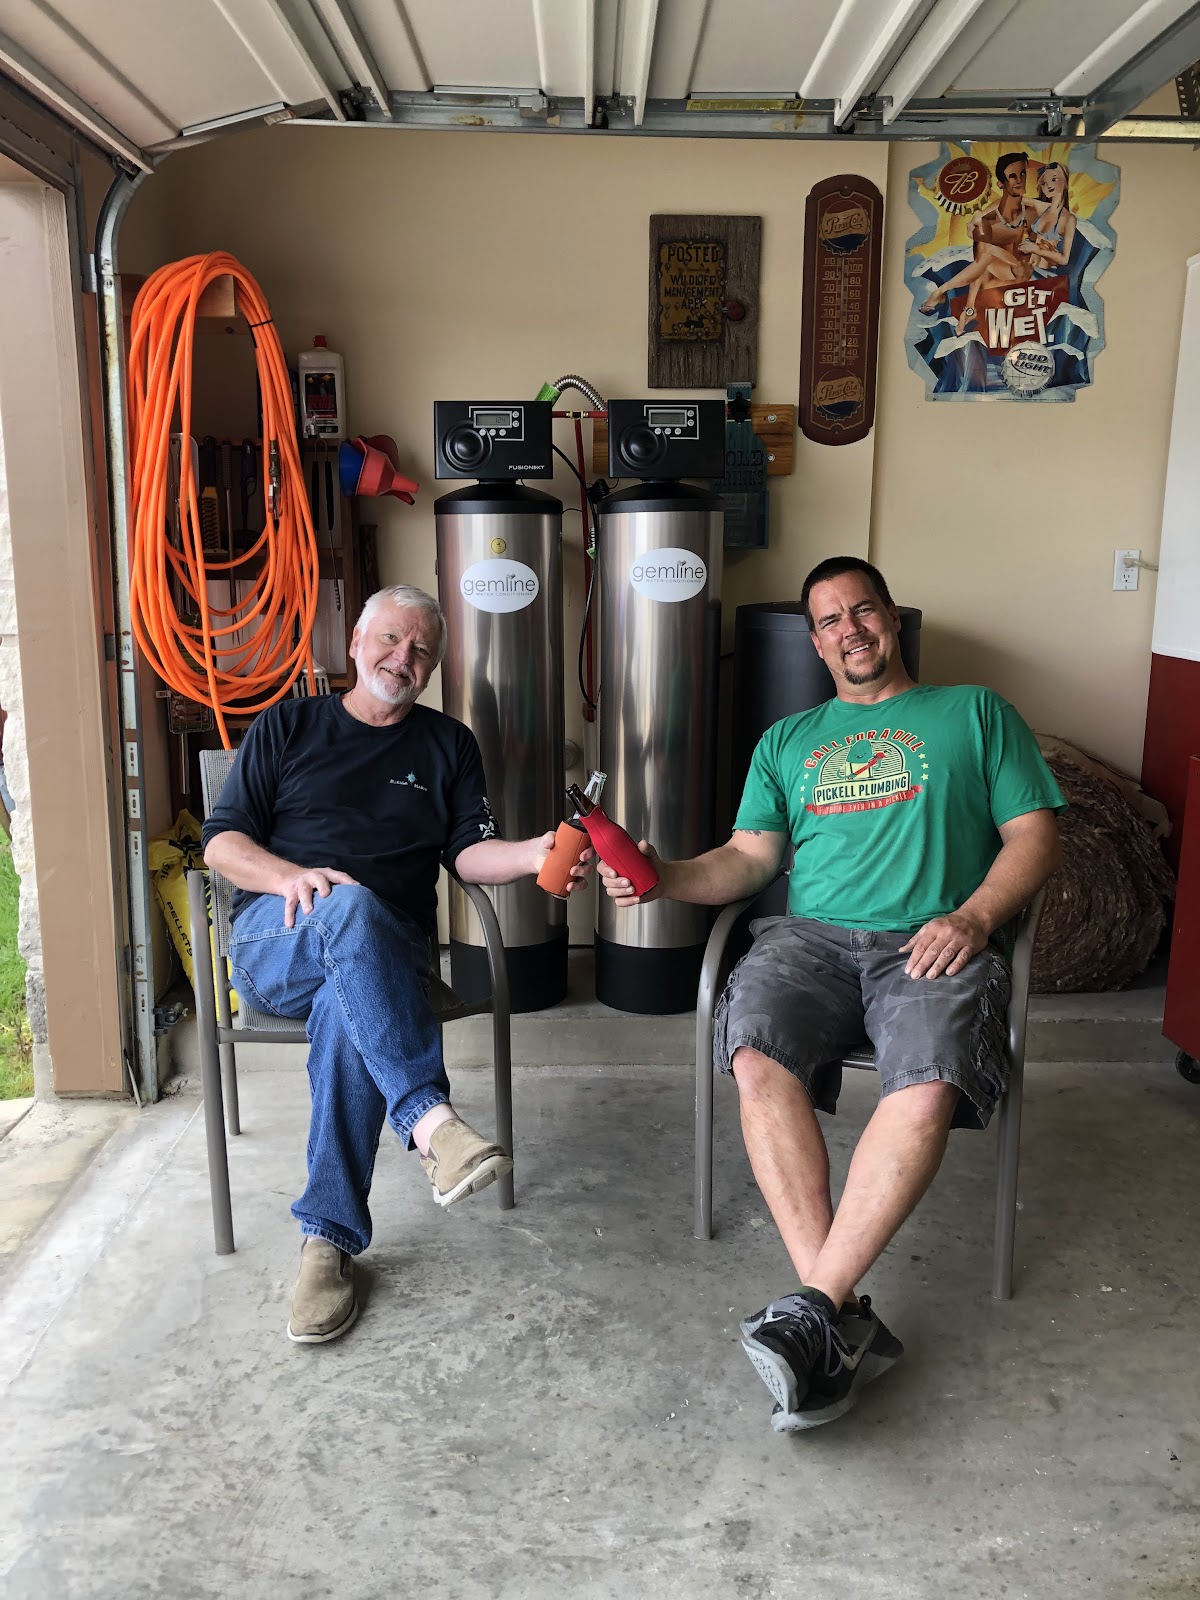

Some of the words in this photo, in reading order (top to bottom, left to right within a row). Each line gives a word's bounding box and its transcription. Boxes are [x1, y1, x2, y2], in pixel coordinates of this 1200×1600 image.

[667, 245, 719, 263] POSTED
[849, 263, 863, 272] 100
[824, 271, 836, 279] 90
[849, 276, 861, 285] 80
[664, 286, 720, 298] MANAGEMENT
[824, 283, 835, 292] 70
[849, 289, 860, 298] 60
[1003, 286, 1052, 309] GET
[823, 296, 834, 304] 50
[849, 302, 860, 310] 40
[823, 308, 834, 316] 30
[848, 314, 860, 322] 20
[824, 320, 834, 328] 10
[987, 306, 1055, 349] WET.
[850, 326, 857, 334] 0
[823, 332, 833, 340] 10
[1017, 351, 1048, 364] BUD
[1014, 360, 1051, 374] LIGHT
[726, 450, 764, 467] OLD
[632, 560, 705, 582] gemline
[463, 573, 536, 596] gemline
[804, 741, 842, 769] CALL
[845, 730, 877, 745] FOR
[880, 728, 891, 740] A
[892, 729, 925, 753] DILL
[816, 784, 856, 803] PICKELL
[858, 776, 907, 797] PLUMBING
[885, 793, 908, 805] PICKLE
